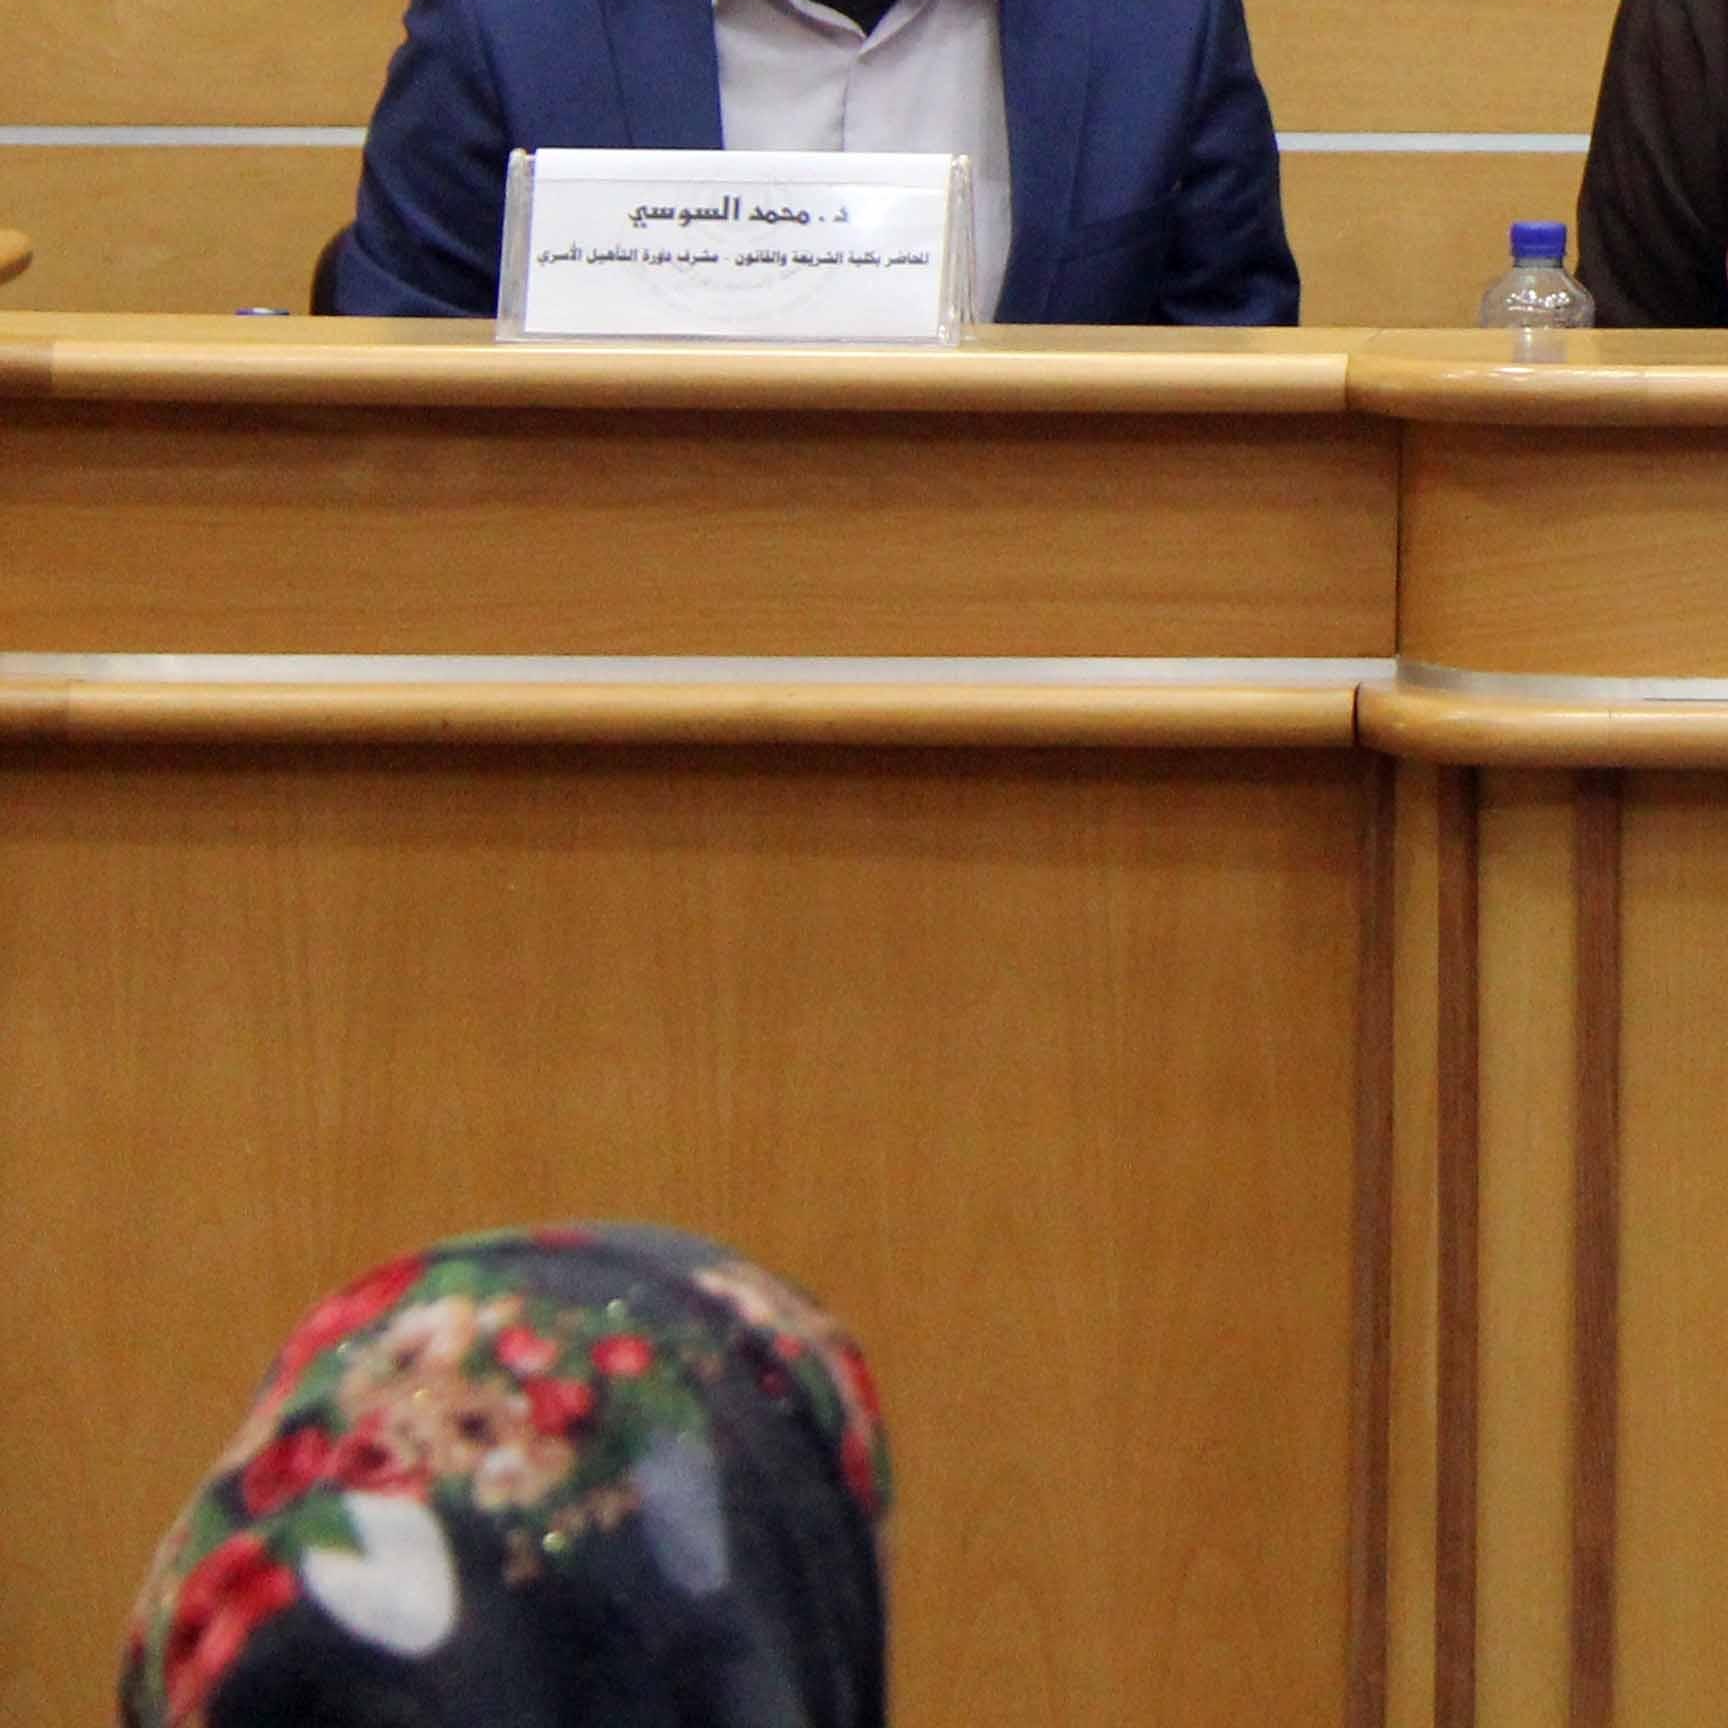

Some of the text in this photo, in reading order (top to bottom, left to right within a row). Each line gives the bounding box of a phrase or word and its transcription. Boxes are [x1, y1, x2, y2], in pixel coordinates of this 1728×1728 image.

[627, 196, 740, 228] السوسي
[749, 205, 810, 224] محمد
[536, 240, 582, 266] الأسري
[586, 244, 638, 264] التأهيل
[642, 248, 672, 265] دورة
[676, 249, 719, 265] مشرف
[734, 249, 788, 267] والقانون
[791, 249, 844, 267] الشريعة
